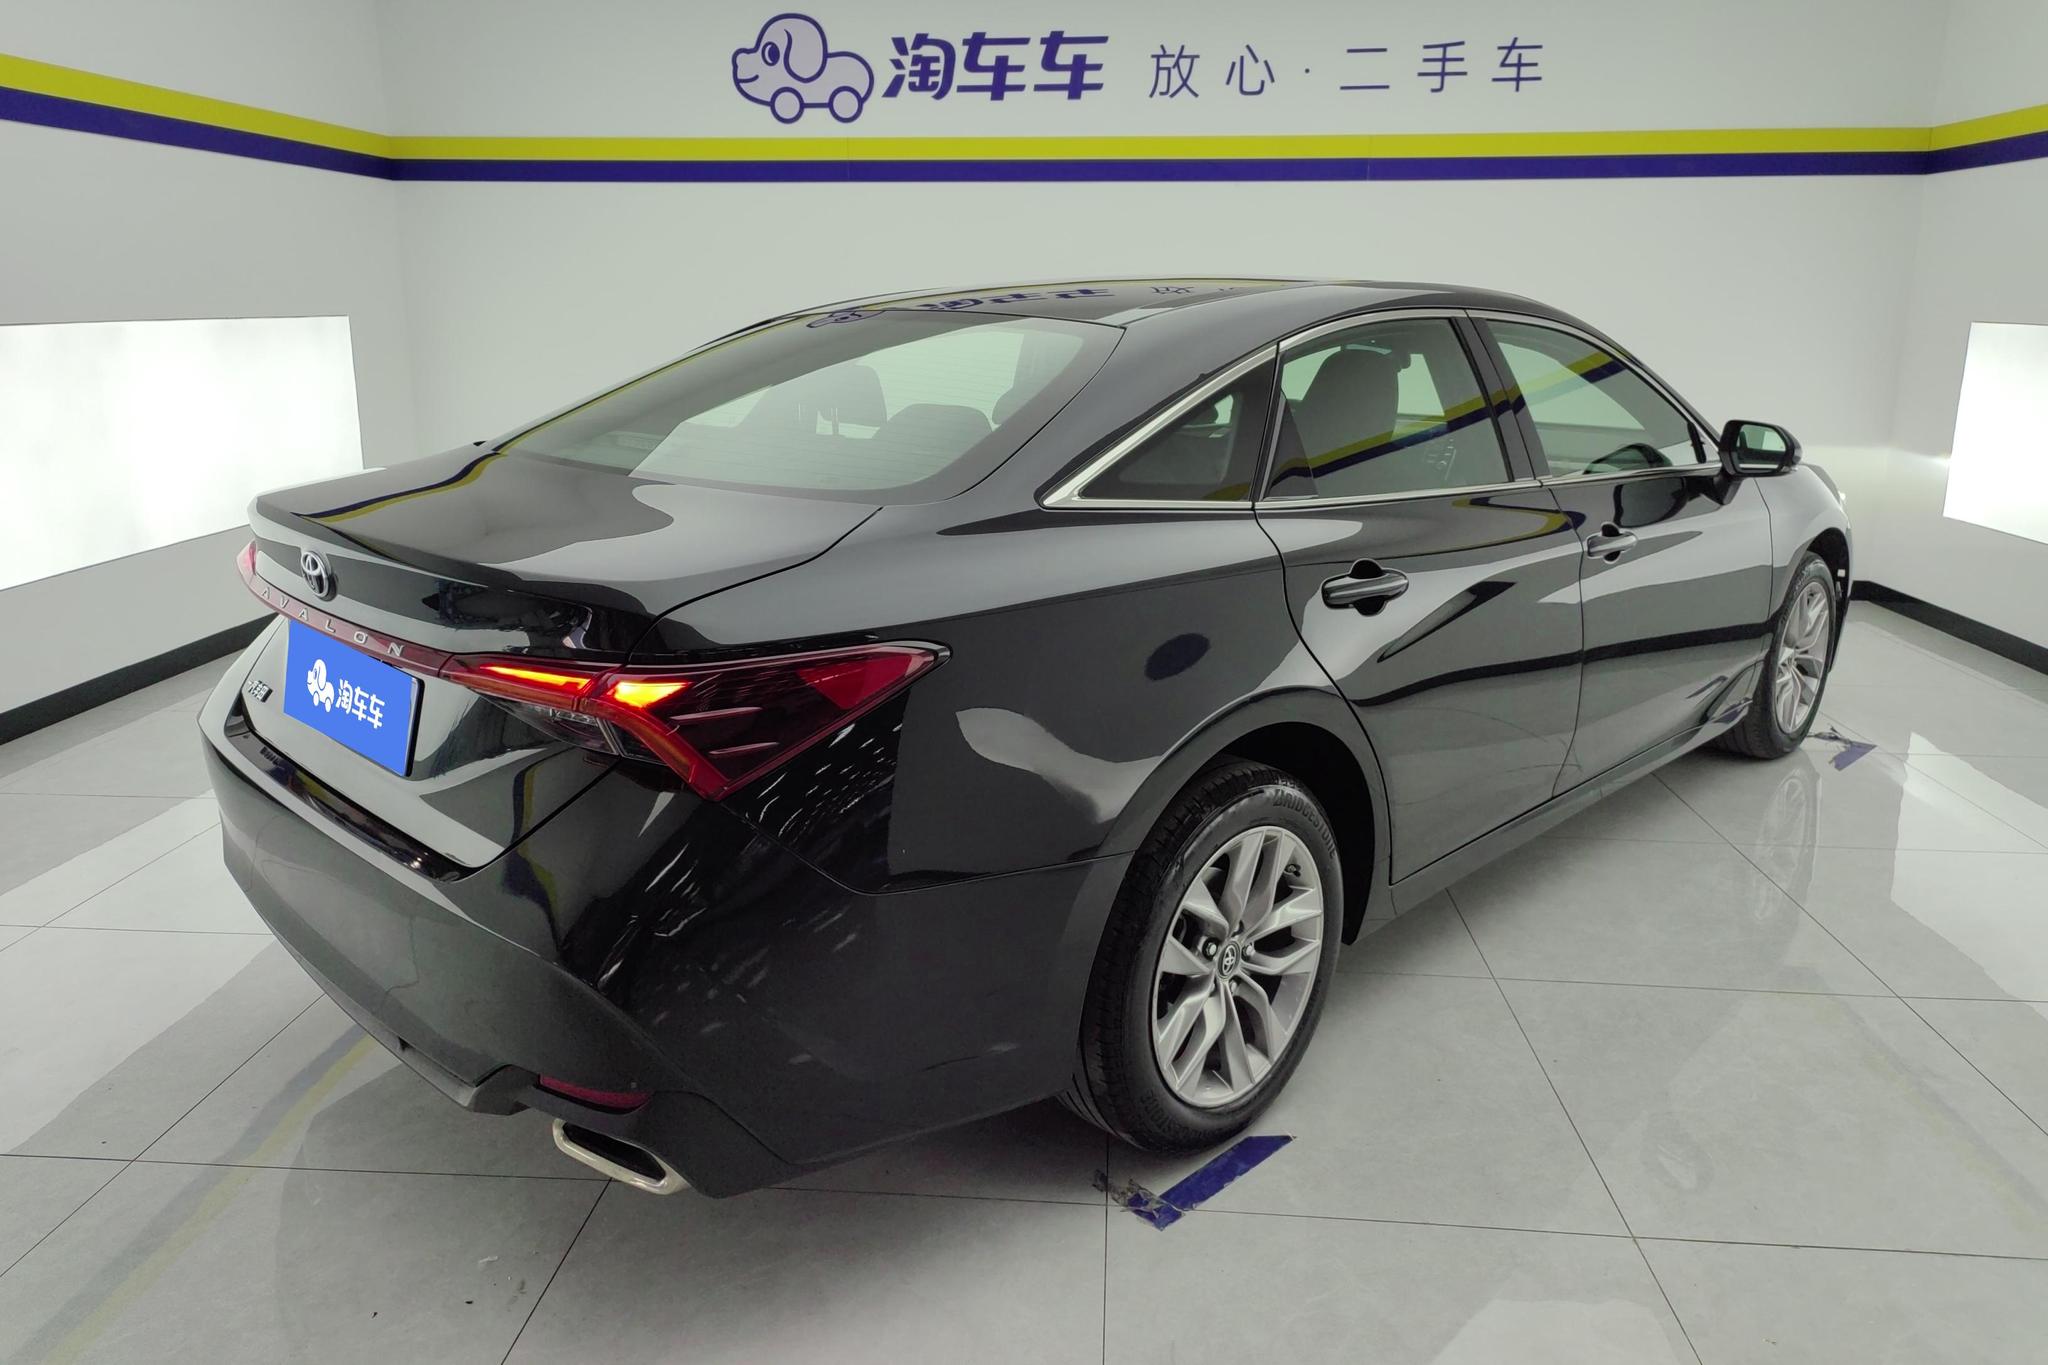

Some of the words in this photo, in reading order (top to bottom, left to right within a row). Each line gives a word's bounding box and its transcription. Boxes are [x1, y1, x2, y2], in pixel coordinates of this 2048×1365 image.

[882, 31, 1109, 101] 淘车车
[261, 587, 404, 657] AVALON
[1273, 788, 1337, 860] BRIDGESTONE
